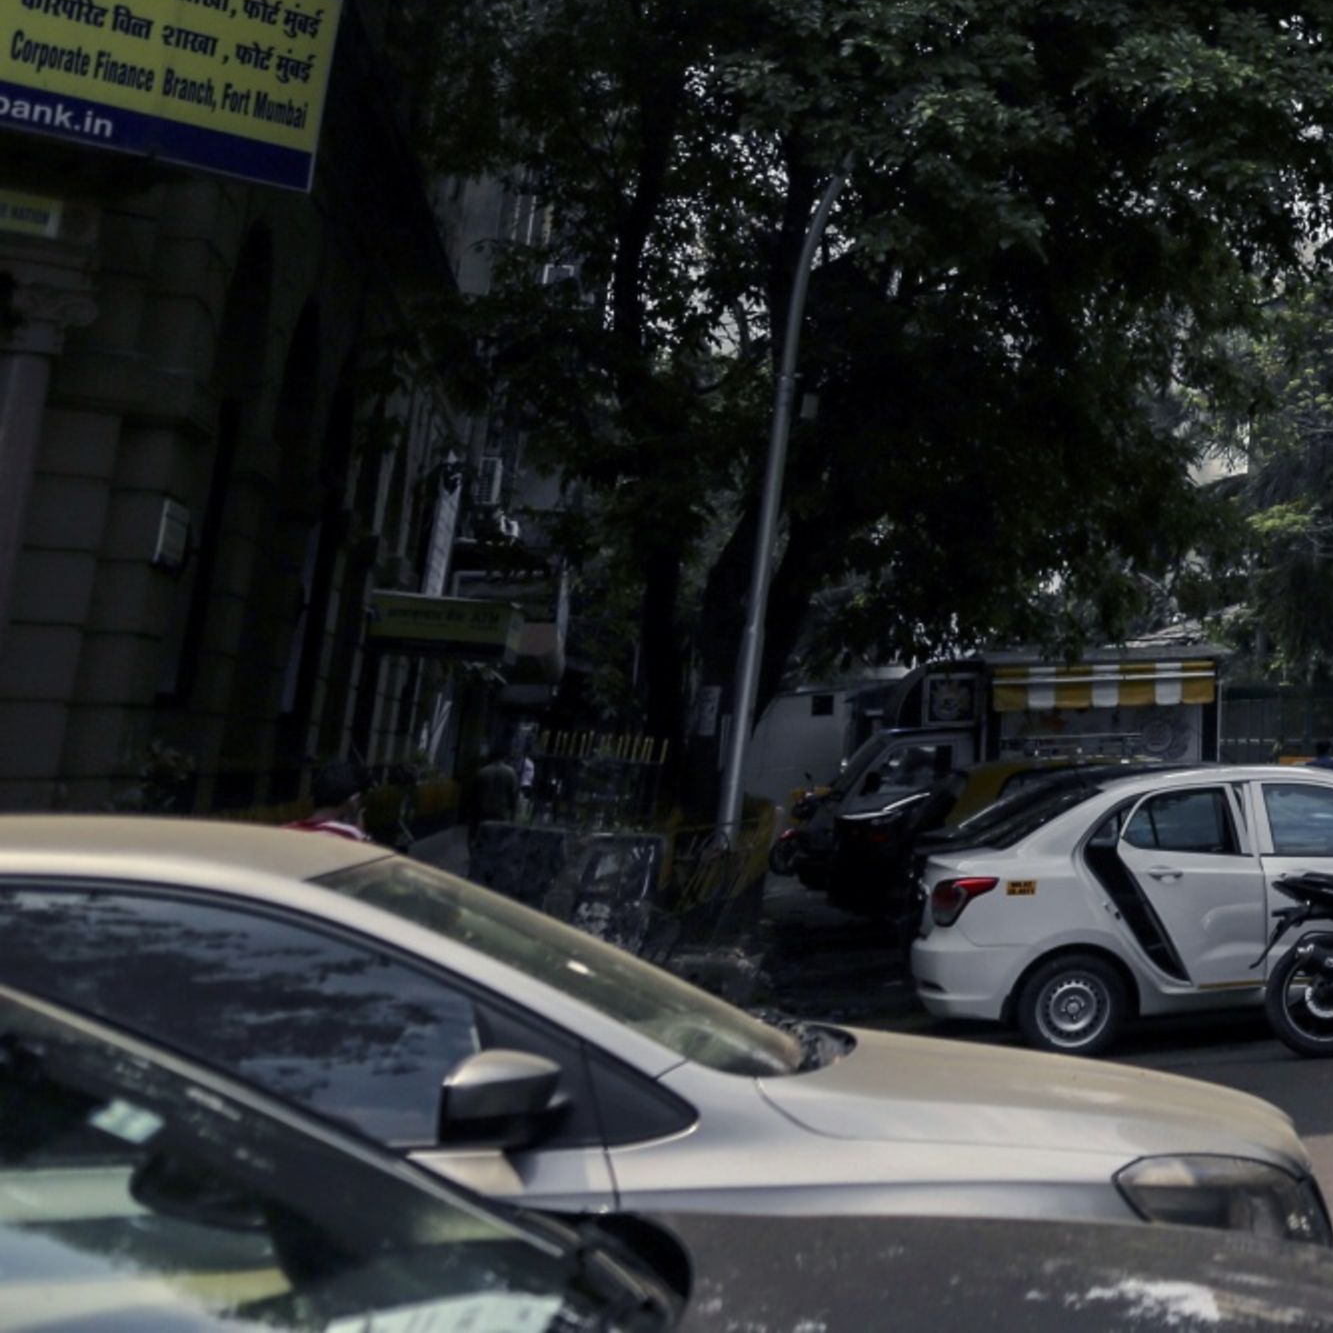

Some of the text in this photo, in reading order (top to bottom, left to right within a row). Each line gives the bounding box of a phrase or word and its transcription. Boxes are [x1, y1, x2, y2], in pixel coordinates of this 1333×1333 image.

[284, 2, 325, 39] मुंबई
[10, 29, 310, 131] Corporate Finance Branch, Fort Mumbai
[235, 41, 273, 73] फोर्ट
[275, 48, 316, 84] मुंबई
